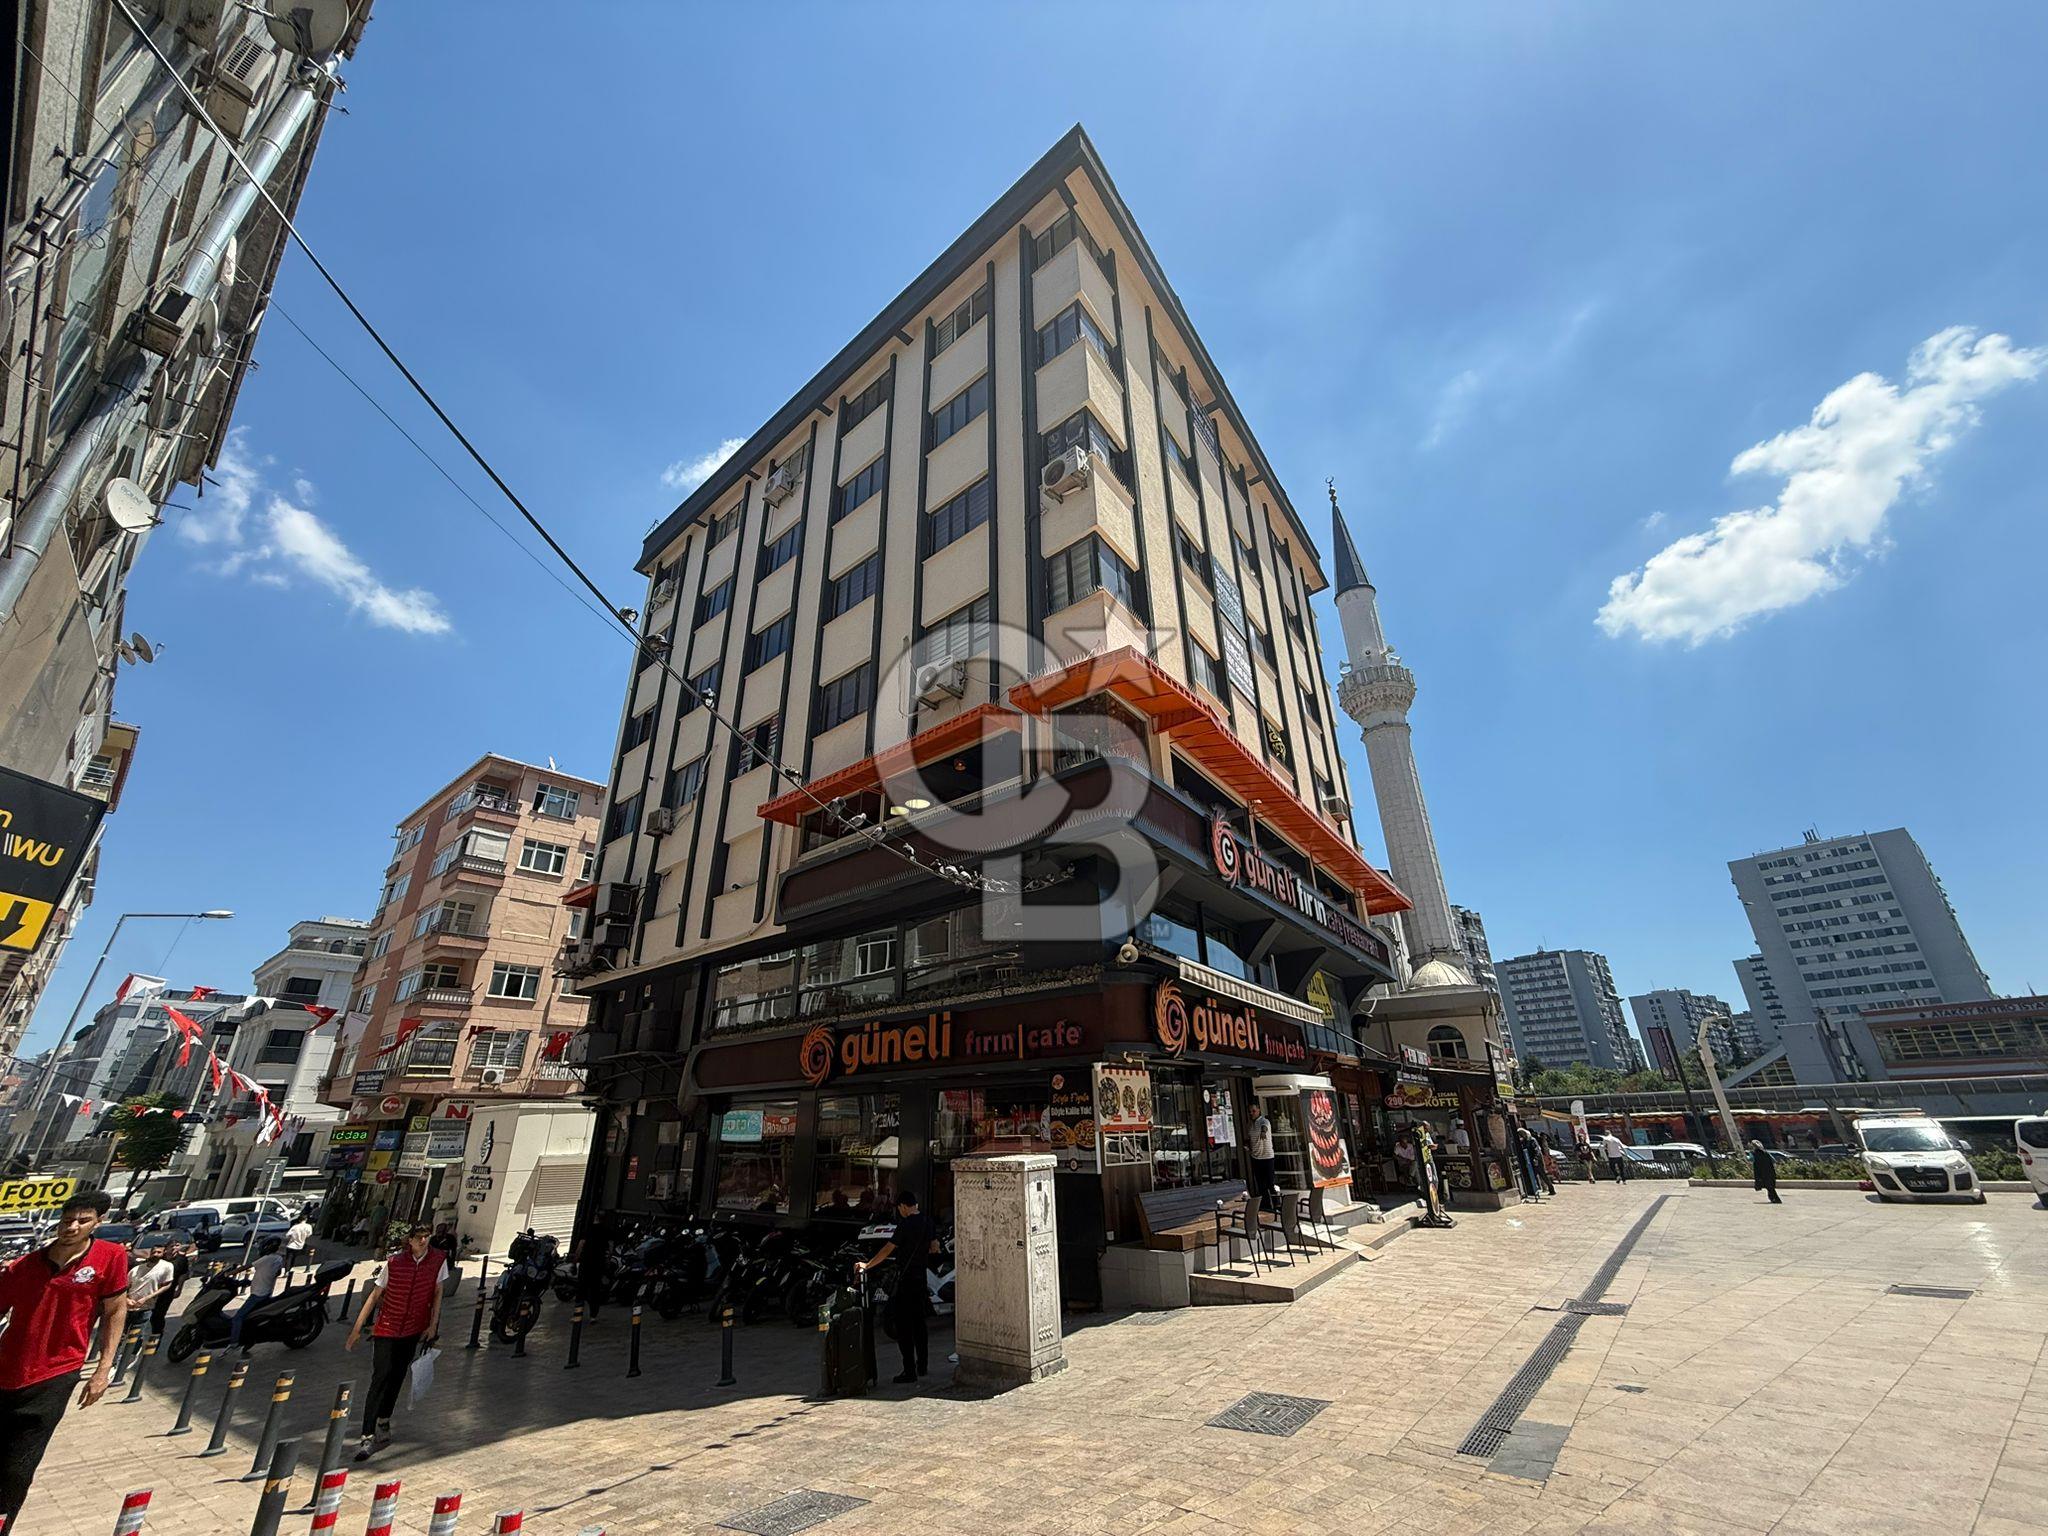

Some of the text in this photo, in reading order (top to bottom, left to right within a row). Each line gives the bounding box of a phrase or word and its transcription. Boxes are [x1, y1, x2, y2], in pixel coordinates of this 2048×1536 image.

[13, 836, 64, 867] WU
[1244, 850, 1297, 908] güneli
[841, 1011, 951, 1076] güneli
[965, 1030, 1015, 1056] fırın
[1027, 1019, 1081, 1049] cafe
[1193, 997, 1260, 1051] güneli
[1424, 1095, 1460, 1107] KÖFTE
[3, 1181, 69, 1201] FOTO
